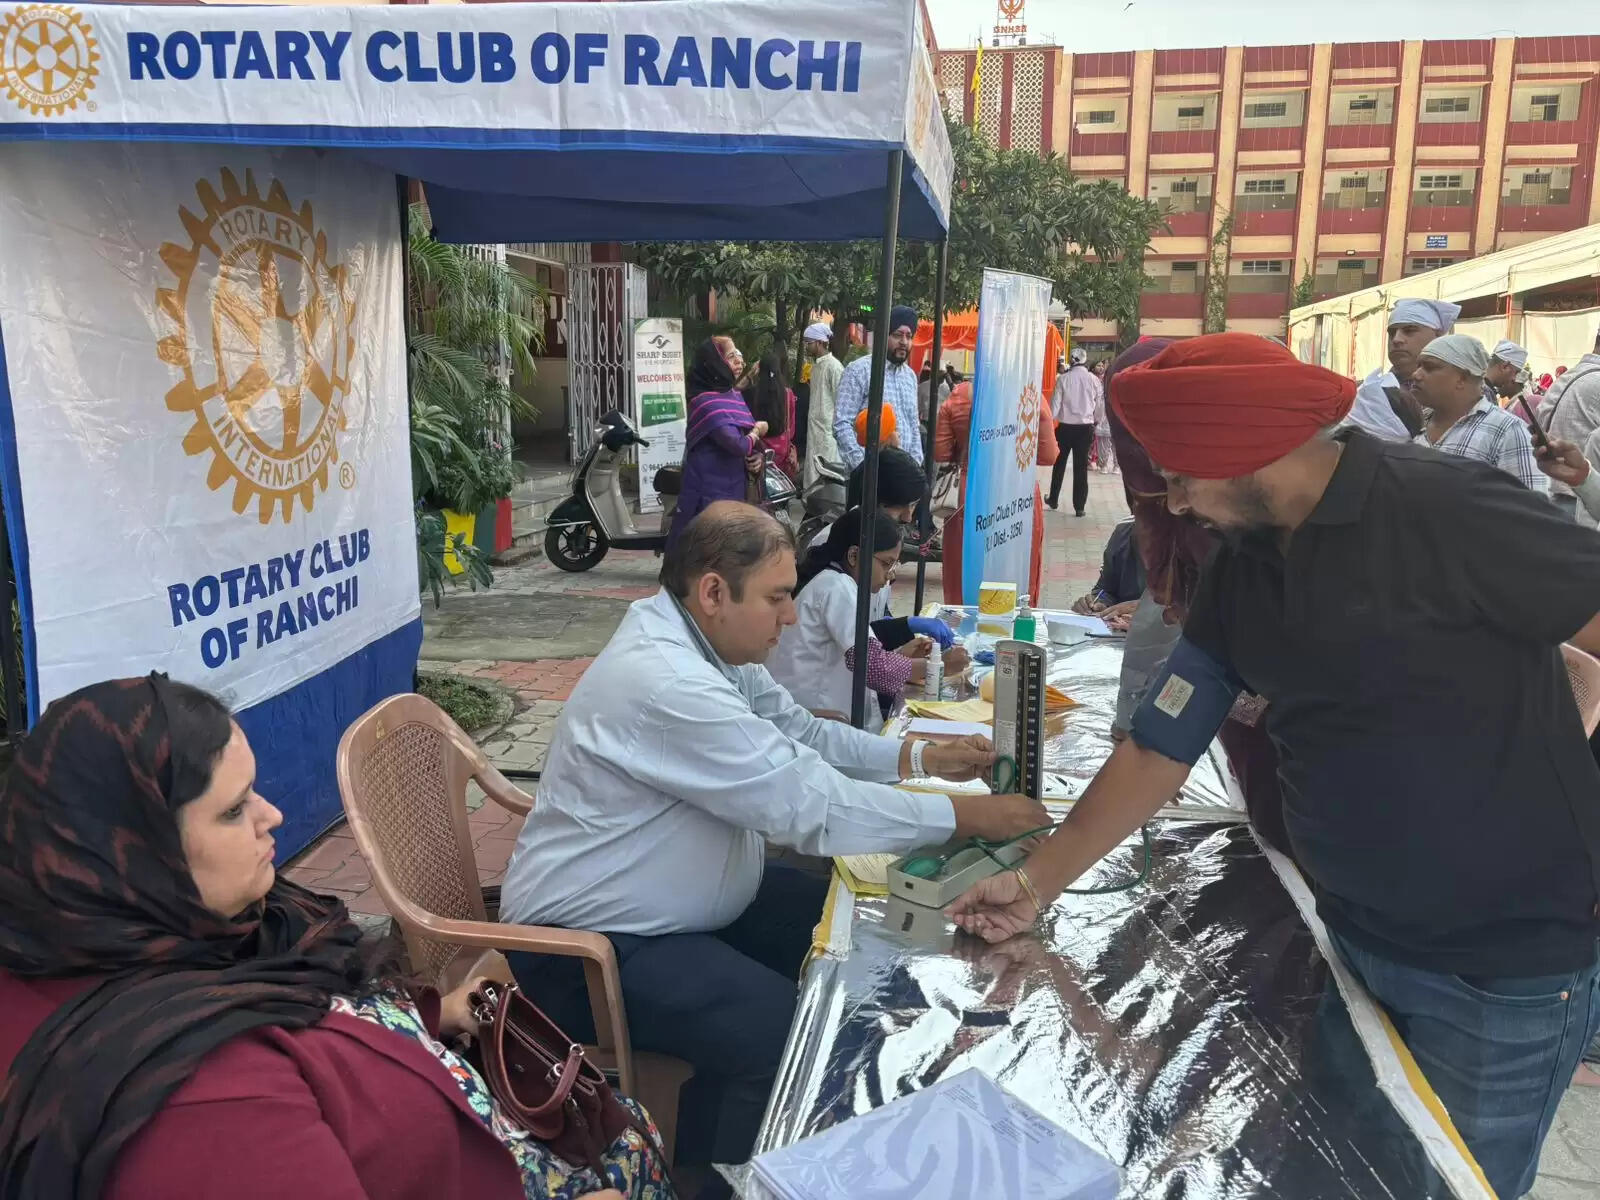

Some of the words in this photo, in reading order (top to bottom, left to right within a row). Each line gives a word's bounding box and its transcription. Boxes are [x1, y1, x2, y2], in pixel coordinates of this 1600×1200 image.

[128, 31, 353, 81] ROTARY
[365, 31, 517, 84] CLUB
[530, 32, 609, 85] OF
[624, 34, 862, 93] RANCHI
[219, 209, 310, 244] ROTARY
[212, 401, 341, 487] INTERNATIONAL
[995, 505, 1010, 522] Club
[167, 549, 305, 628] ROTARY
[310, 528, 371, 579] CLUB
[200, 617, 248, 669] OF
[256, 575, 359, 650] RANCHI
